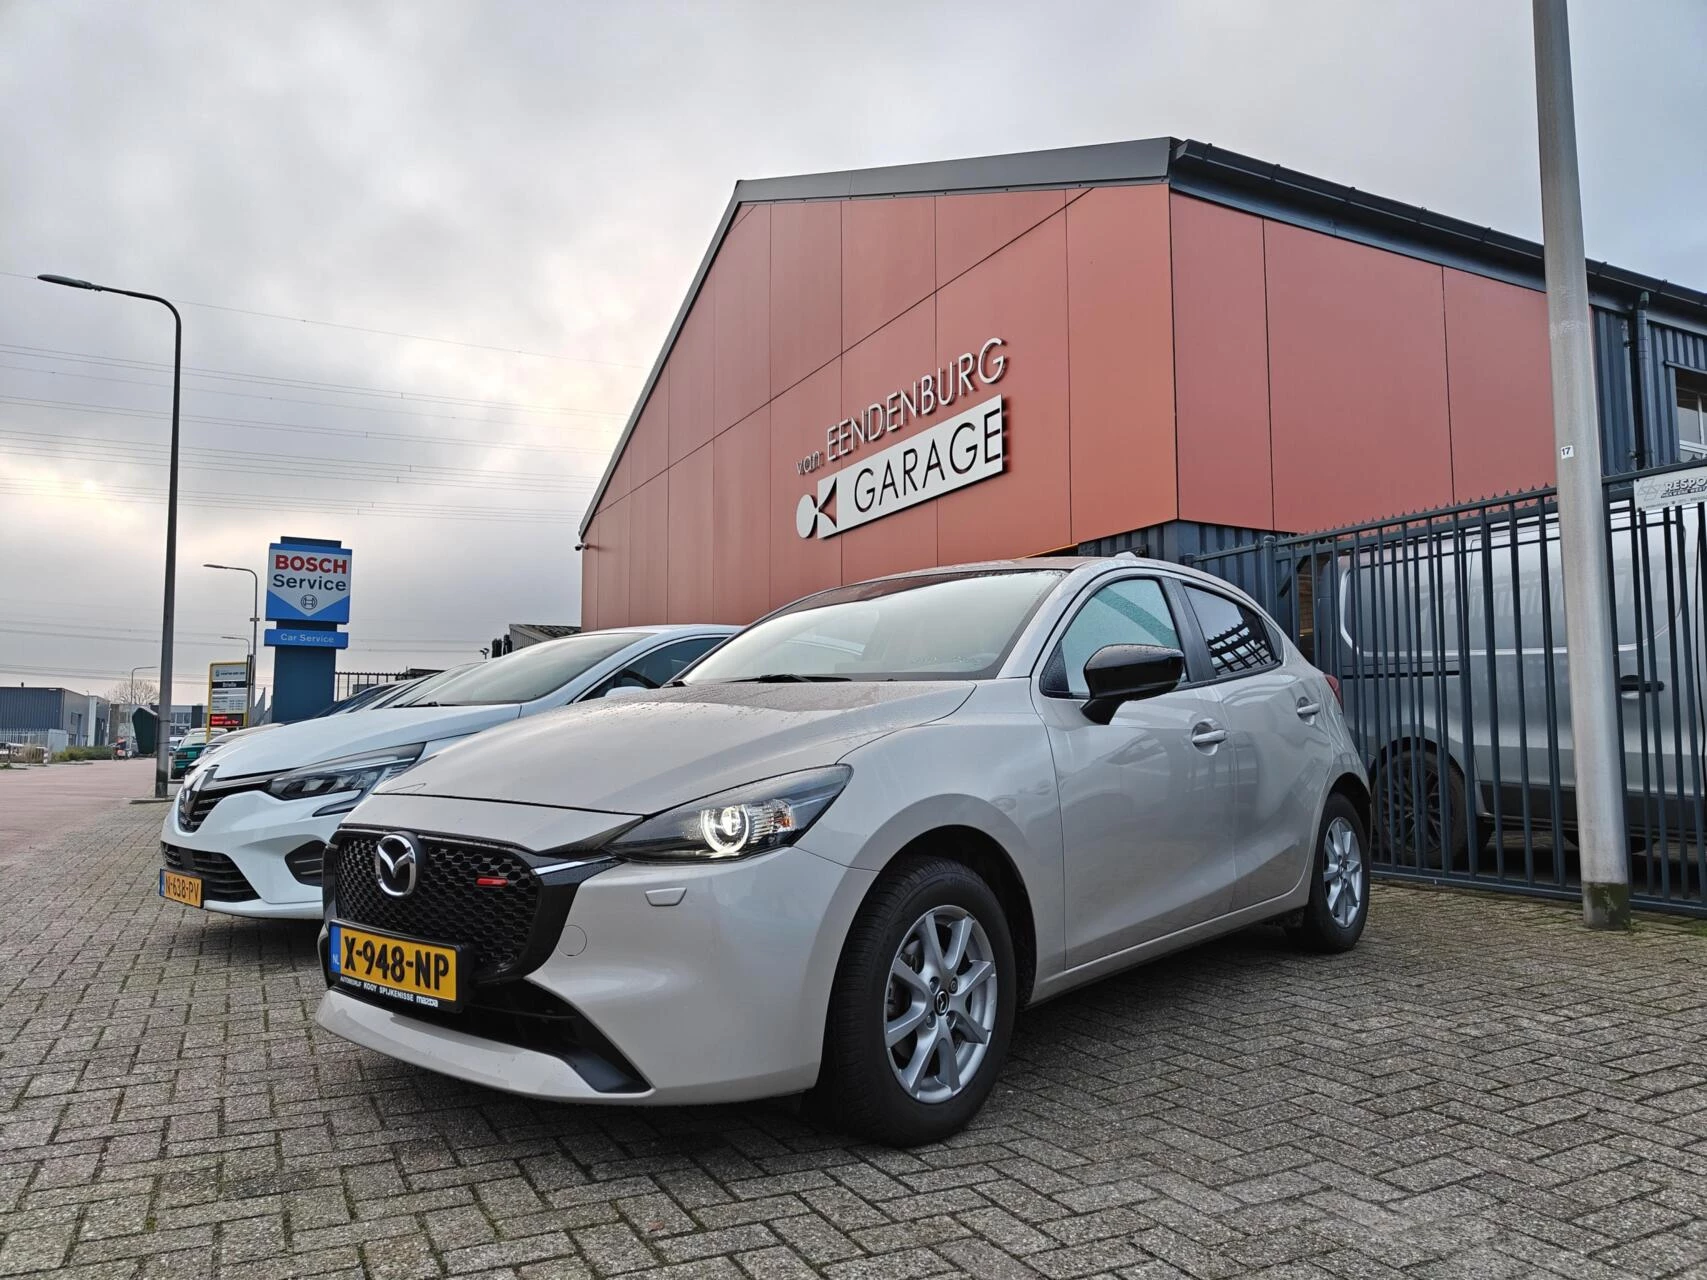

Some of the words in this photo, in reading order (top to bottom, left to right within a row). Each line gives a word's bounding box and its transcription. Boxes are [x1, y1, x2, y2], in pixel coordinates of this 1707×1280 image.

[796, 451, 821, 475] van
[827, 337, 1005, 461] EENDENBURG
[1561, 447, 1571, 455] 17
[854, 408, 1001, 513] GARAGE
[275, 554, 347, 574] BOSCH
[272, 574, 346, 591] Service
[280, 633, 297, 642] Car
[299, 634, 334, 643] Service
[344, 936, 449, 990] X-948-NP
[379, 986, 414, 1002] SPIJKENISSE
